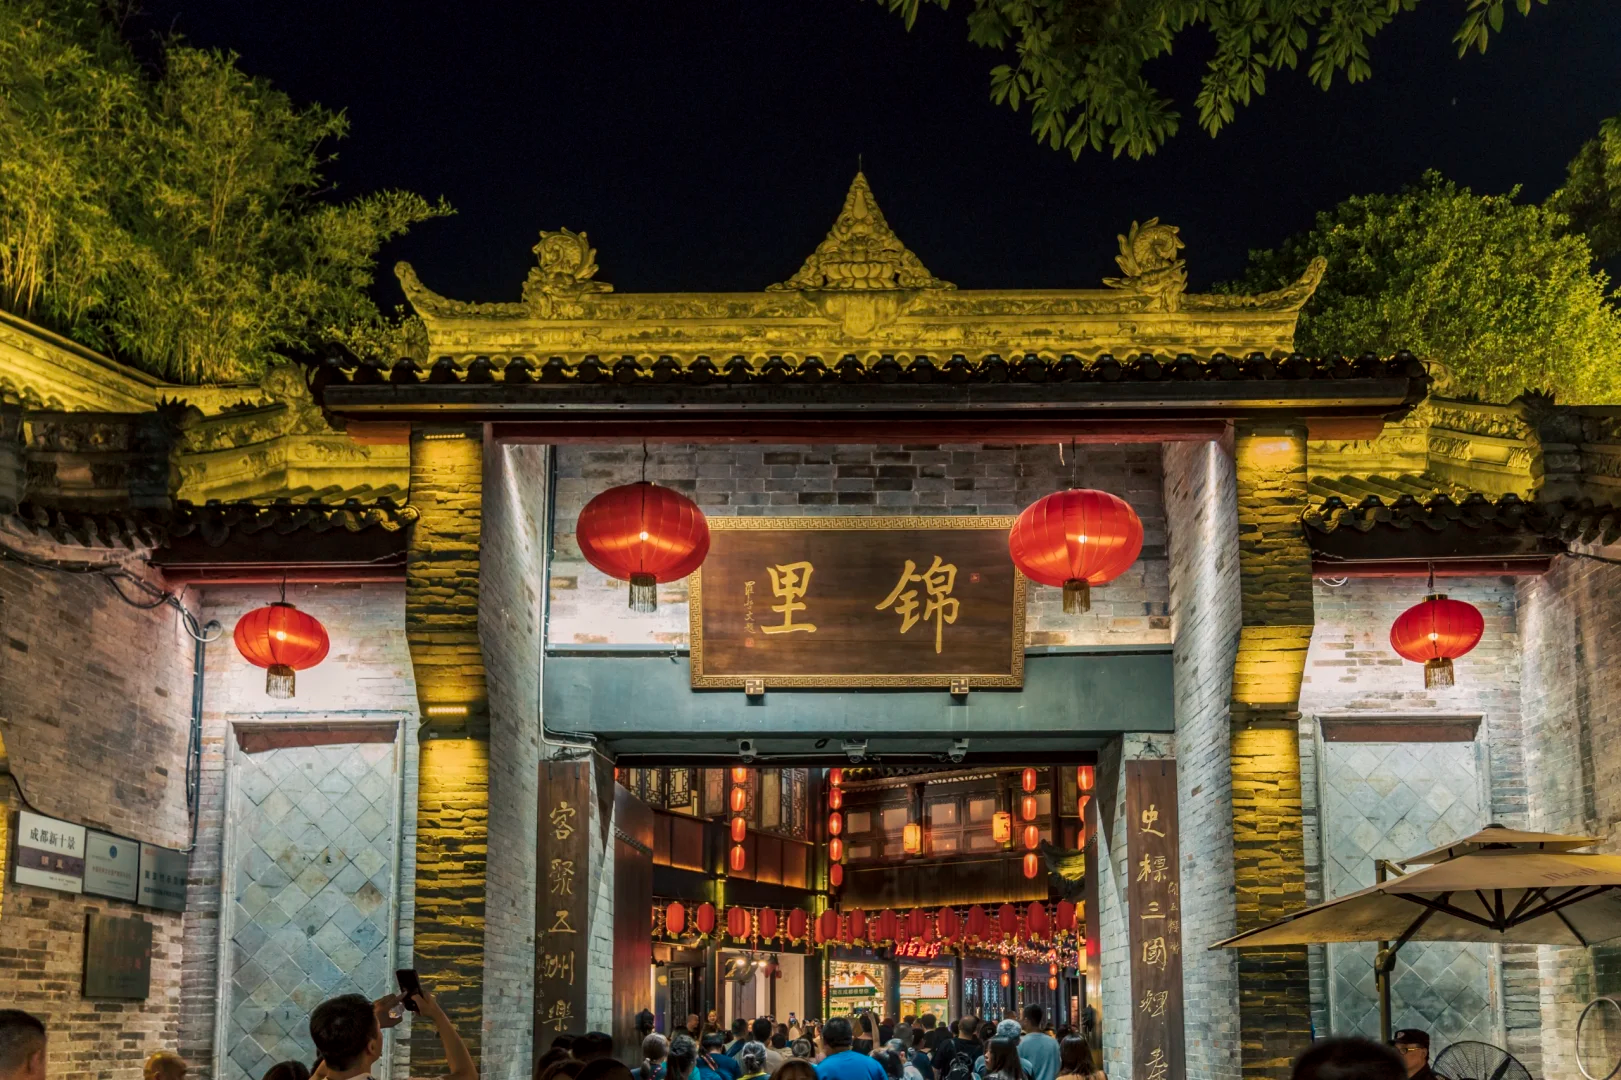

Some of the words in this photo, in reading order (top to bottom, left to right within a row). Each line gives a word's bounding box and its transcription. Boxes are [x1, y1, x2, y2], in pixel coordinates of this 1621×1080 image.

[30, 827, 76, 850] 成都新十景
